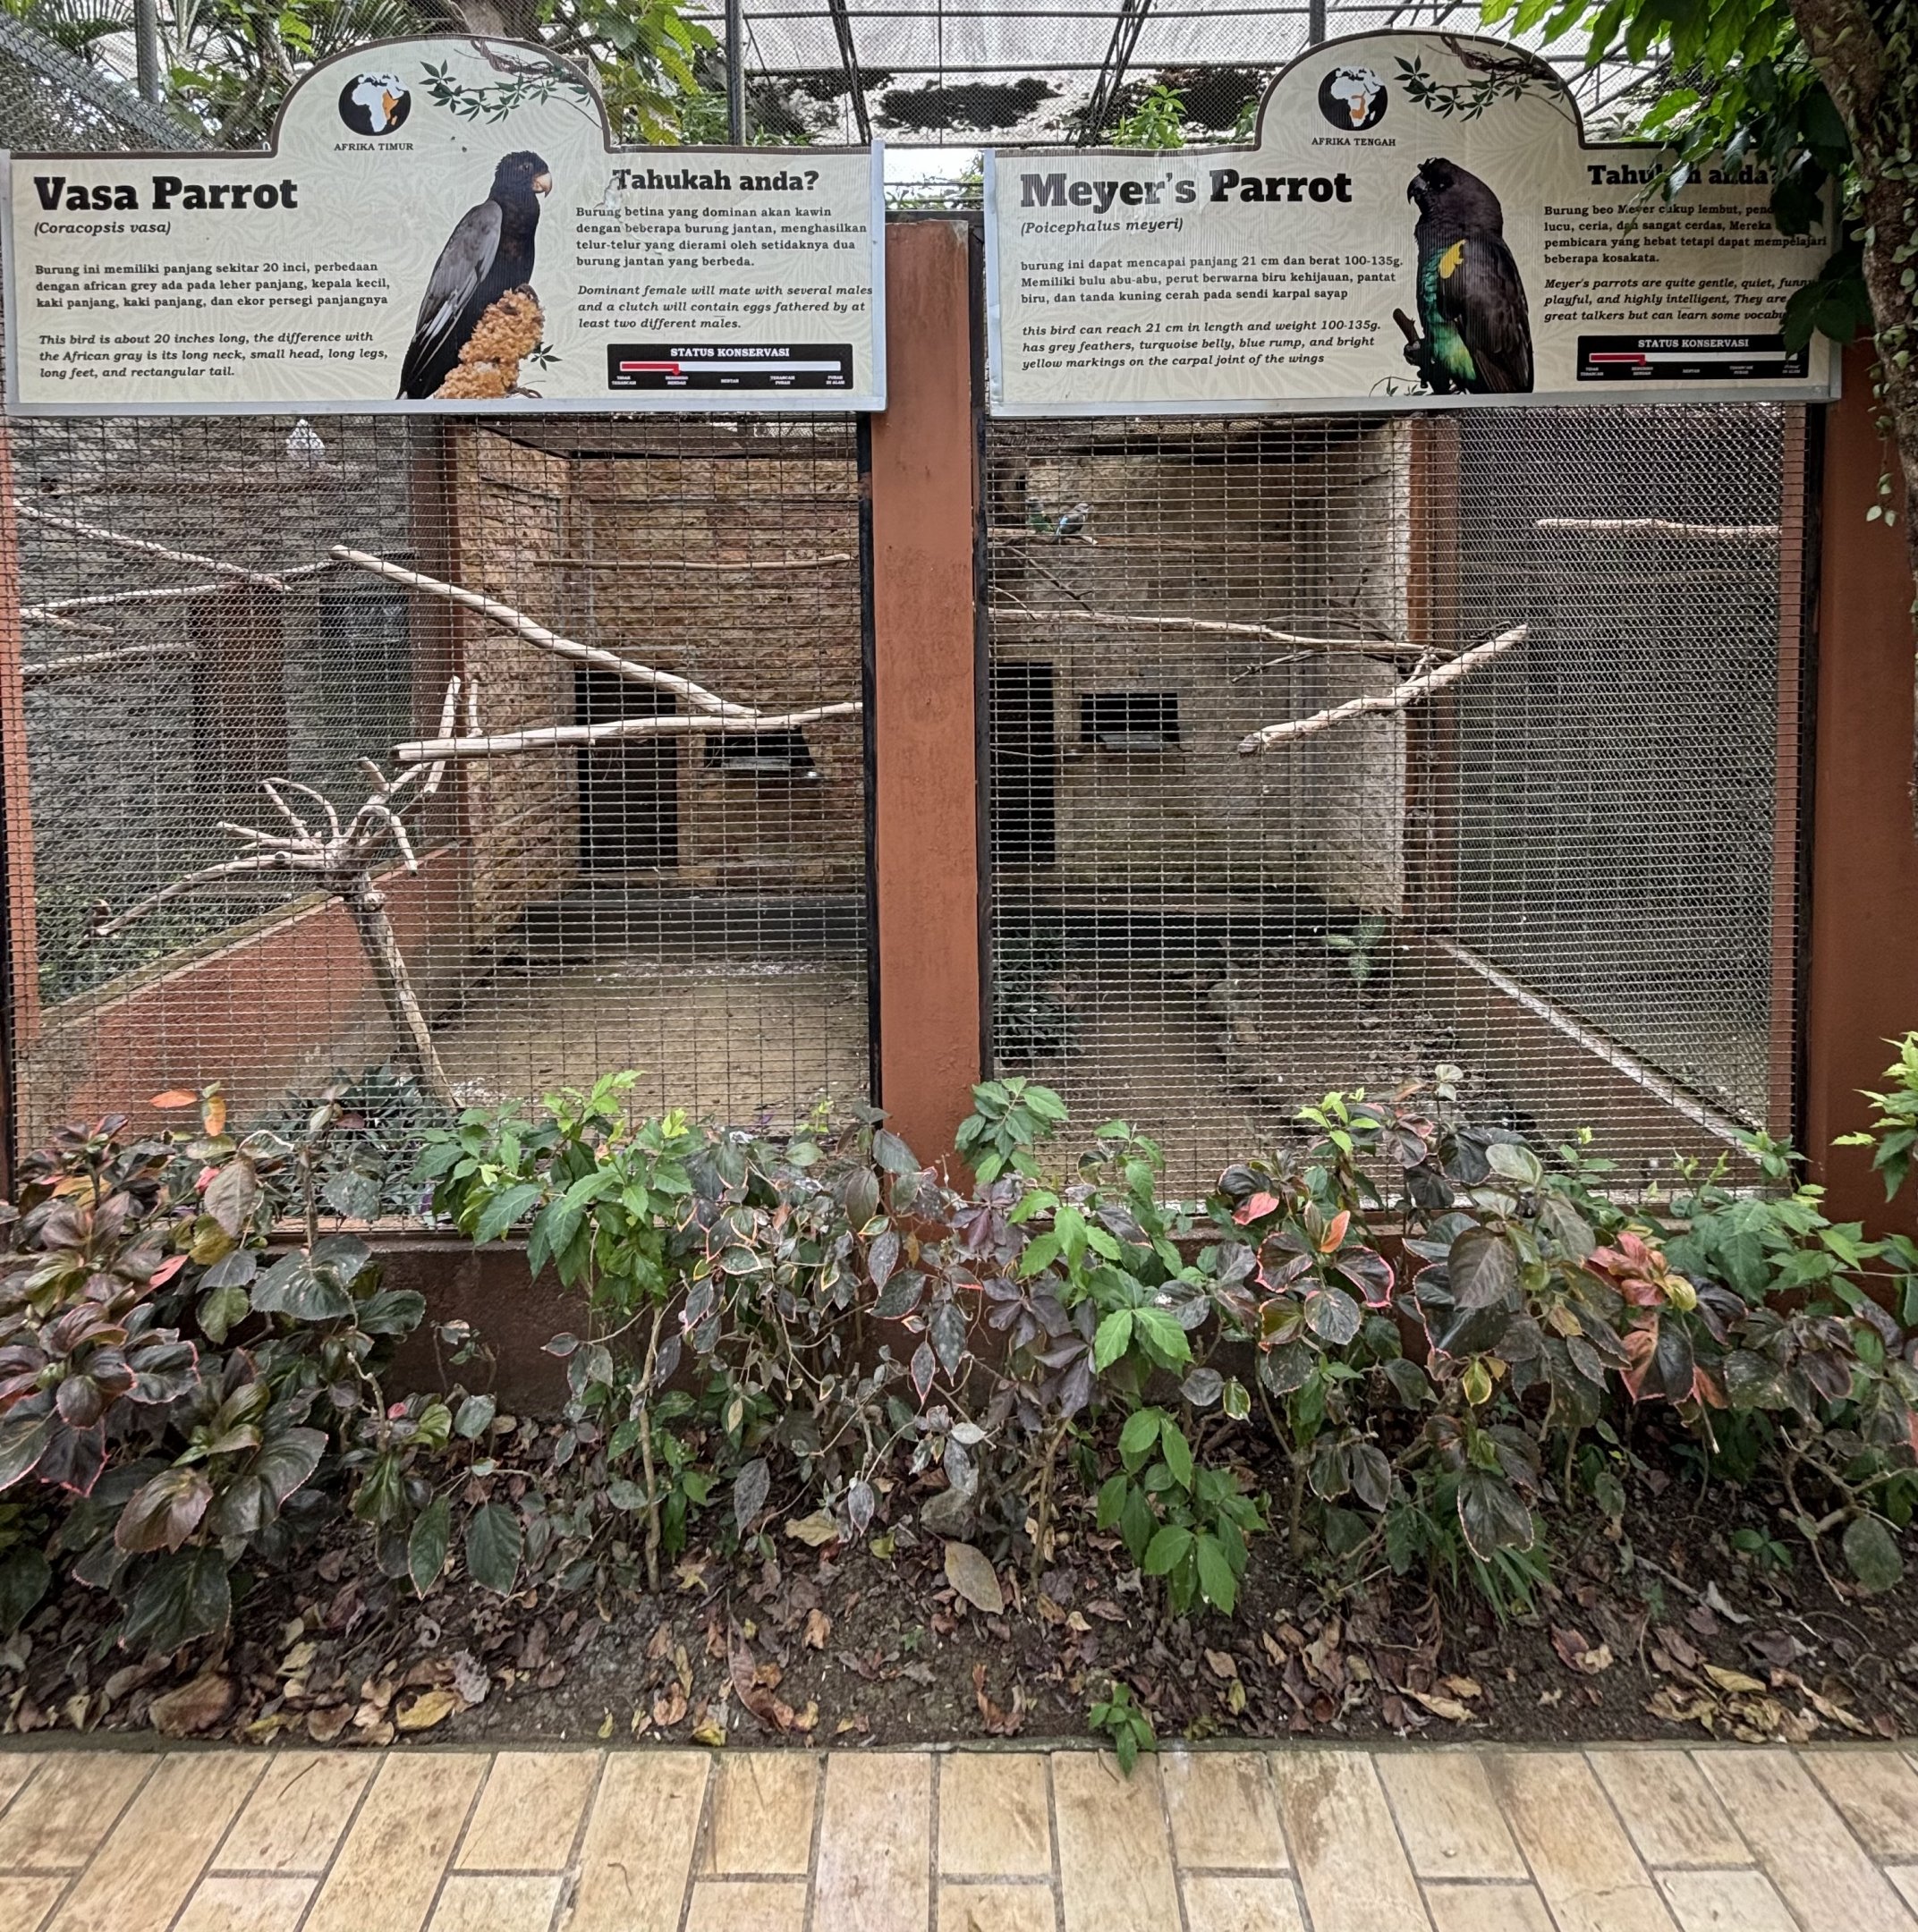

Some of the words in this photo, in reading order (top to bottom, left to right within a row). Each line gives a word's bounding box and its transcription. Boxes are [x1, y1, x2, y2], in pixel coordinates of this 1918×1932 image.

[333, 142, 375, 151] AFRIKA
[378, 142, 413, 150] TIMUR
[1311, 137, 1351, 145] AFRIKA
[1353, 138, 1396, 146] TENGAH
[612, 168, 731, 191] Tahukah
[739, 170, 819, 191] anda?
[33, 176, 139, 211] Vasa
[152, 175, 297, 209] Parrot
[1020, 172, 1196, 214] Meyer's
[1209, 168, 1352, 202] Parrot
[575, 207, 621, 219] Burung
[624, 206, 664, 216] betina
[667, 208, 698, 219] yang
[702, 207, 757, 216] dominan
[760, 207, 791, 216] akan
[794, 206, 831, 216] kawin
[34, 221, 124, 236] (Coracopsis
[130, 221, 170, 235] vasa)
[575, 223, 621, 235] dengan
[624, 223, 681, 235] beberapa
[684, 223, 729, 235] burung
[731, 223, 776, 235] jantan,
[780, 223, 867, 235] menghasilkan
[1021, 219, 1120, 237] (Poicephalus
[1125, 217, 1183, 233] meyeri)
[575, 239, 641, 249] telur-telur
[643, 242, 675, 251] yang
[678, 240, 726, 250] dierami
[730, 240, 757, 250] oleh
[761, 239, 828, 251] setidaknya
[833, 239, 855, 249] dua
[1544, 237, 1608, 250] pembicara
[1610, 238, 1640, 249] yang
[1643, 235, 1676, 246] hebat
[1680, 236, 1714, 249] tetapi
[1718, 236, 1750, 249] dapat
[1753, 237, 1827, 248] mempelajari
[575, 256, 621, 268] burung
[623, 256, 664, 267] jantan
[667, 258, 698, 268] yang
[701, 256, 754, 266] berbeda.
[1020, 261, 1064, 272] burung
[1067, 258, 1084, 269] ini
[1088, 258, 1122, 271] dapat
[1126, 256, 1185, 269] mencapai
[1189, 256, 1237, 268] panjang
[1241, 256, 1256, 266] 21
[1260, 258, 1279, 266] cm
[1283, 255, 1305, 265] dan
[1309, 255, 1340, 265] berat
[1345, 255, 1403, 267] 100-135g.
[1543, 253, 1598, 265] beberapa
[1602, 252, 1659, 262] kosakata.
[35, 265, 80, 276] Burung
[83, 264, 100, 274] ini
[104, 263, 159, 274] memiliki
[163, 263, 212, 275] panjang
[216, 262, 259, 273] sekitar
[262, 262, 278, 272] 20
[283, 261, 310, 273] inci,
[314, 261, 378, 274] perbedaan
[1544, 278, 1589, 290] Meyer's
[1591, 278, 1638, 290] parrots
[1665, 277, 1695, 290] quite
[1697, 277, 1737, 290] gentle,
[1741, 277, 1775, 290] quiet,
[577, 284, 640, 294] Dominant
[641, 284, 686, 297] female
[691, 284, 715, 295] will
[718, 285, 751, 295] mate
[755, 284, 783, 295] with
[786, 284, 832, 295] several
[836, 284, 872, 294] males
[1021, 293, 1049, 304] biru,
[1053, 292, 1076, 302] dan
[1080, 292, 1115, 301] tanda
[1118, 291, 1161, 302] kuning
[1165, 289, 1199, 300] cerah
[1203, 289, 1232, 301] pada
[1235, 288, 1268, 298] sendi
[1272, 288, 1310, 301] karpal
[1313, 290, 1347, 301] sayap
[36, 297, 64, 307] kaki
[66, 297, 119, 309] panjang,
[123, 296, 150, 307] kaki
[154, 296, 206, 309] panjang,
[210, 296, 233, 306] dan
[236, 295, 265, 306] ekor
[268, 294, 313, 308] persegi
[317, 294, 387, 307] panjangnya
[1543, 293, 1591, 307] playful,
[1596, 293, 1620, 303] and
[1624, 293, 1662, 306] highly
[1666, 293, 1729, 306] intelligent,
[1733, 293, 1763, 306] They
[578, 301, 602, 311] and
[618, 301, 658, 311] clutch
[663, 301, 686, 311] will
[690, 301, 739, 311] contain
[743, 304, 771, 314] eggs
[773, 301, 829, 314] fathered
[833, 301, 847, 313] by
[851, 301, 865, 310] at
[579, 318, 609, 327] least
[614, 318, 636, 327] two
[640, 318, 696, 330] different
[700, 318, 741, 328] males.
[1023, 326, 1046, 335] this
[1049, 325, 1075, 335] bird
[1106, 323, 1141, 334] reach
[1145, 322, 1160, 333] 21
[1187, 322, 1200, 332] in
[1204, 321, 1243, 334] length
[1247, 320, 1271, 331] and
[1275, 320, 1316, 333] weight
[1320, 319, 1380, 332] 100-135g.
[38, 335, 65, 344] This
[69, 334, 96, 344] bird
[99, 334, 110, 343] is
[114, 334, 150, 343] about
[153, 334, 170, 343] 20
[174, 333, 215, 343] inches
[219, 333, 249, 344] long,
[253, 333, 274, 343] the
[277, 332, 341, 344] difference
[345, 331, 373, 341] with
[1638, 339, 1679, 347] STATUS
[1681, 338, 1748, 347] KONSERVASI
[670, 347, 714, 357] STATUS
[717, 347, 789, 357] KONSERVASI
[1022, 358, 1062, 370] yellow
[1065, 357, 1124, 369] markings
[1148, 356, 1167, 366] the
[1172, 354, 1212, 367] carpal
[1214, 354, 1245, 367] joint
[1248, 353, 1262, 366] of
[1265, 353, 1285, 363] the
[1288, 353, 1324, 365] wings
[39, 368, 66, 379] long
[68, 367, 98, 379] feet,
[101, 367, 126, 377] and
[131, 366, 206, 378] rectangular
[208, 366, 234, 376] tail.
